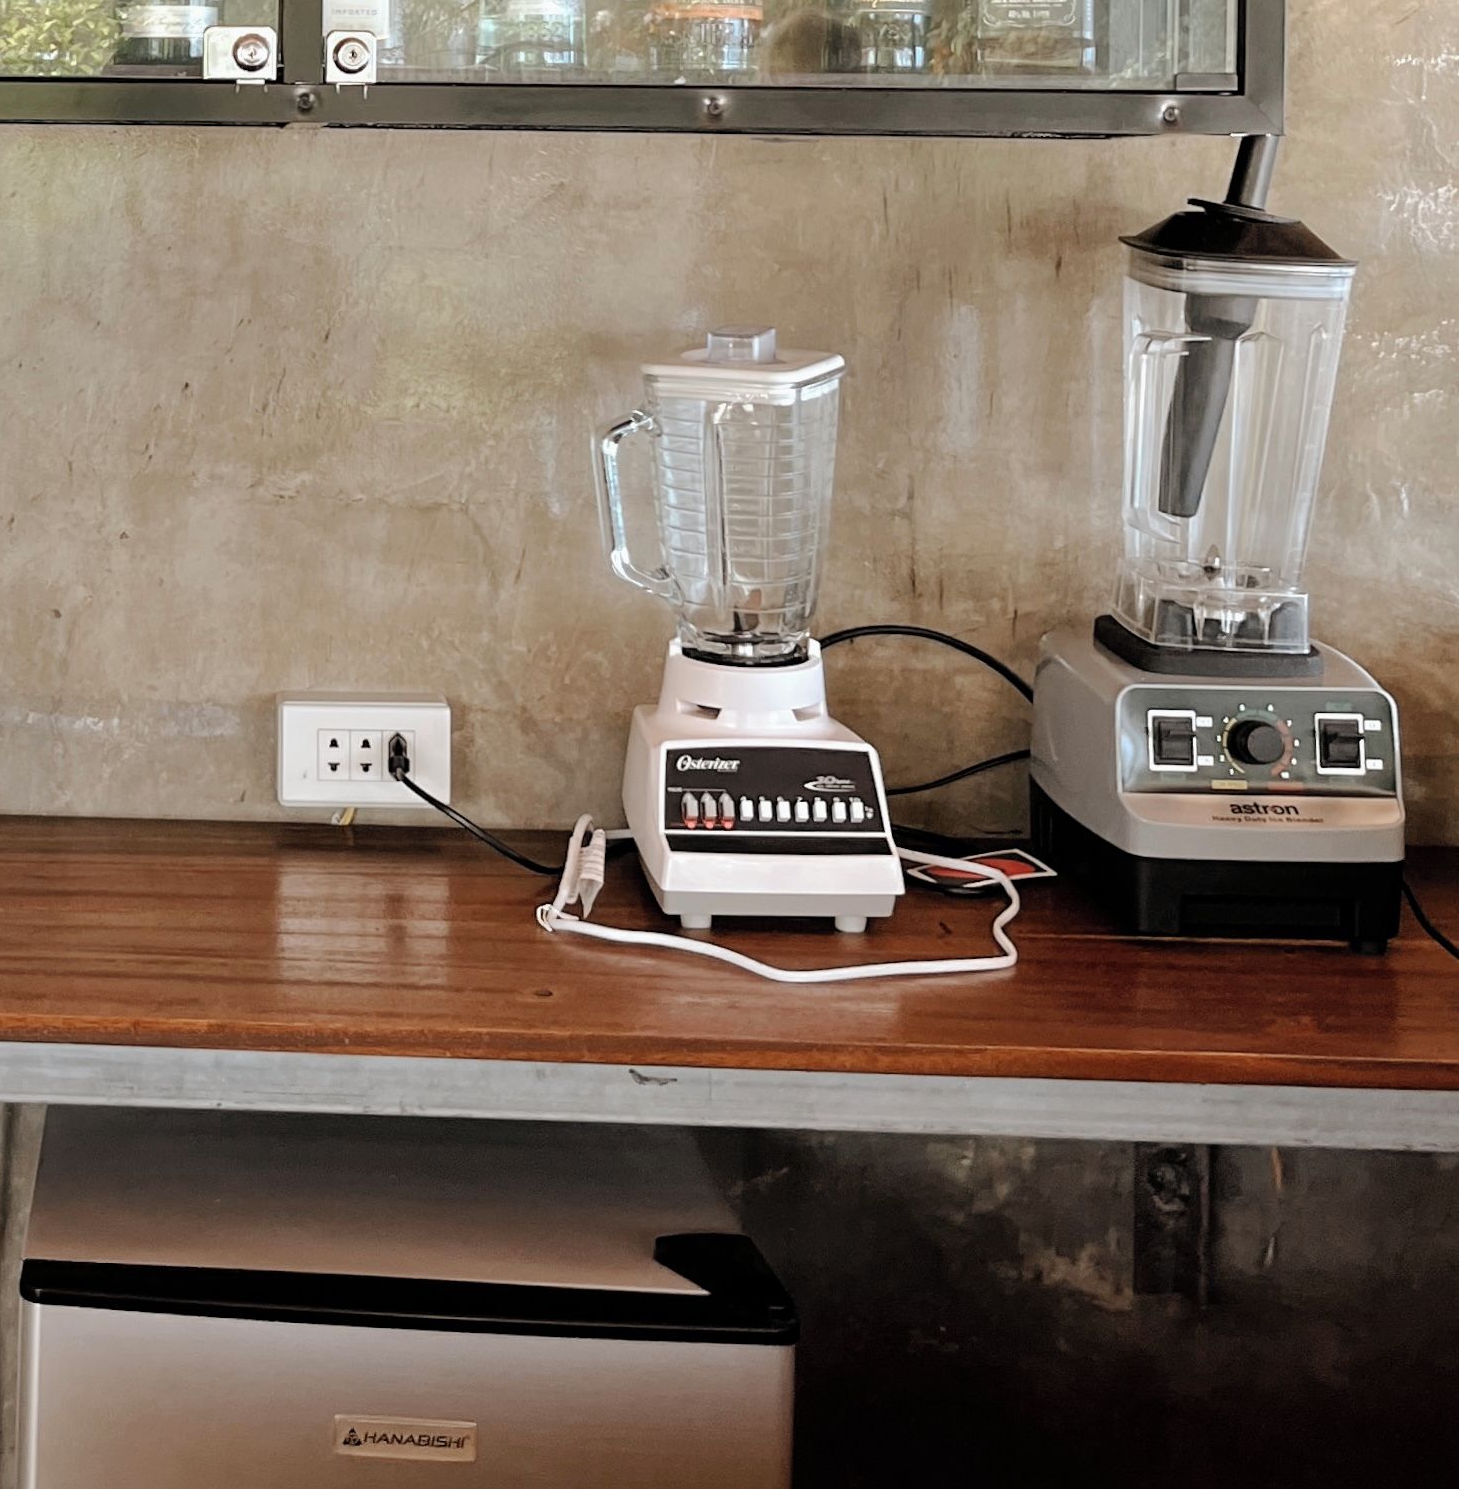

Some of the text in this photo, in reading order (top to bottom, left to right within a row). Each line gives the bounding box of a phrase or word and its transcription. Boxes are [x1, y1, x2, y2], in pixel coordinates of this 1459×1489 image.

[676, 755, 741, 772] Osterizer
[1230, 802, 1300, 815] astron
[364, 1431, 471, 1449] HANABISHI
